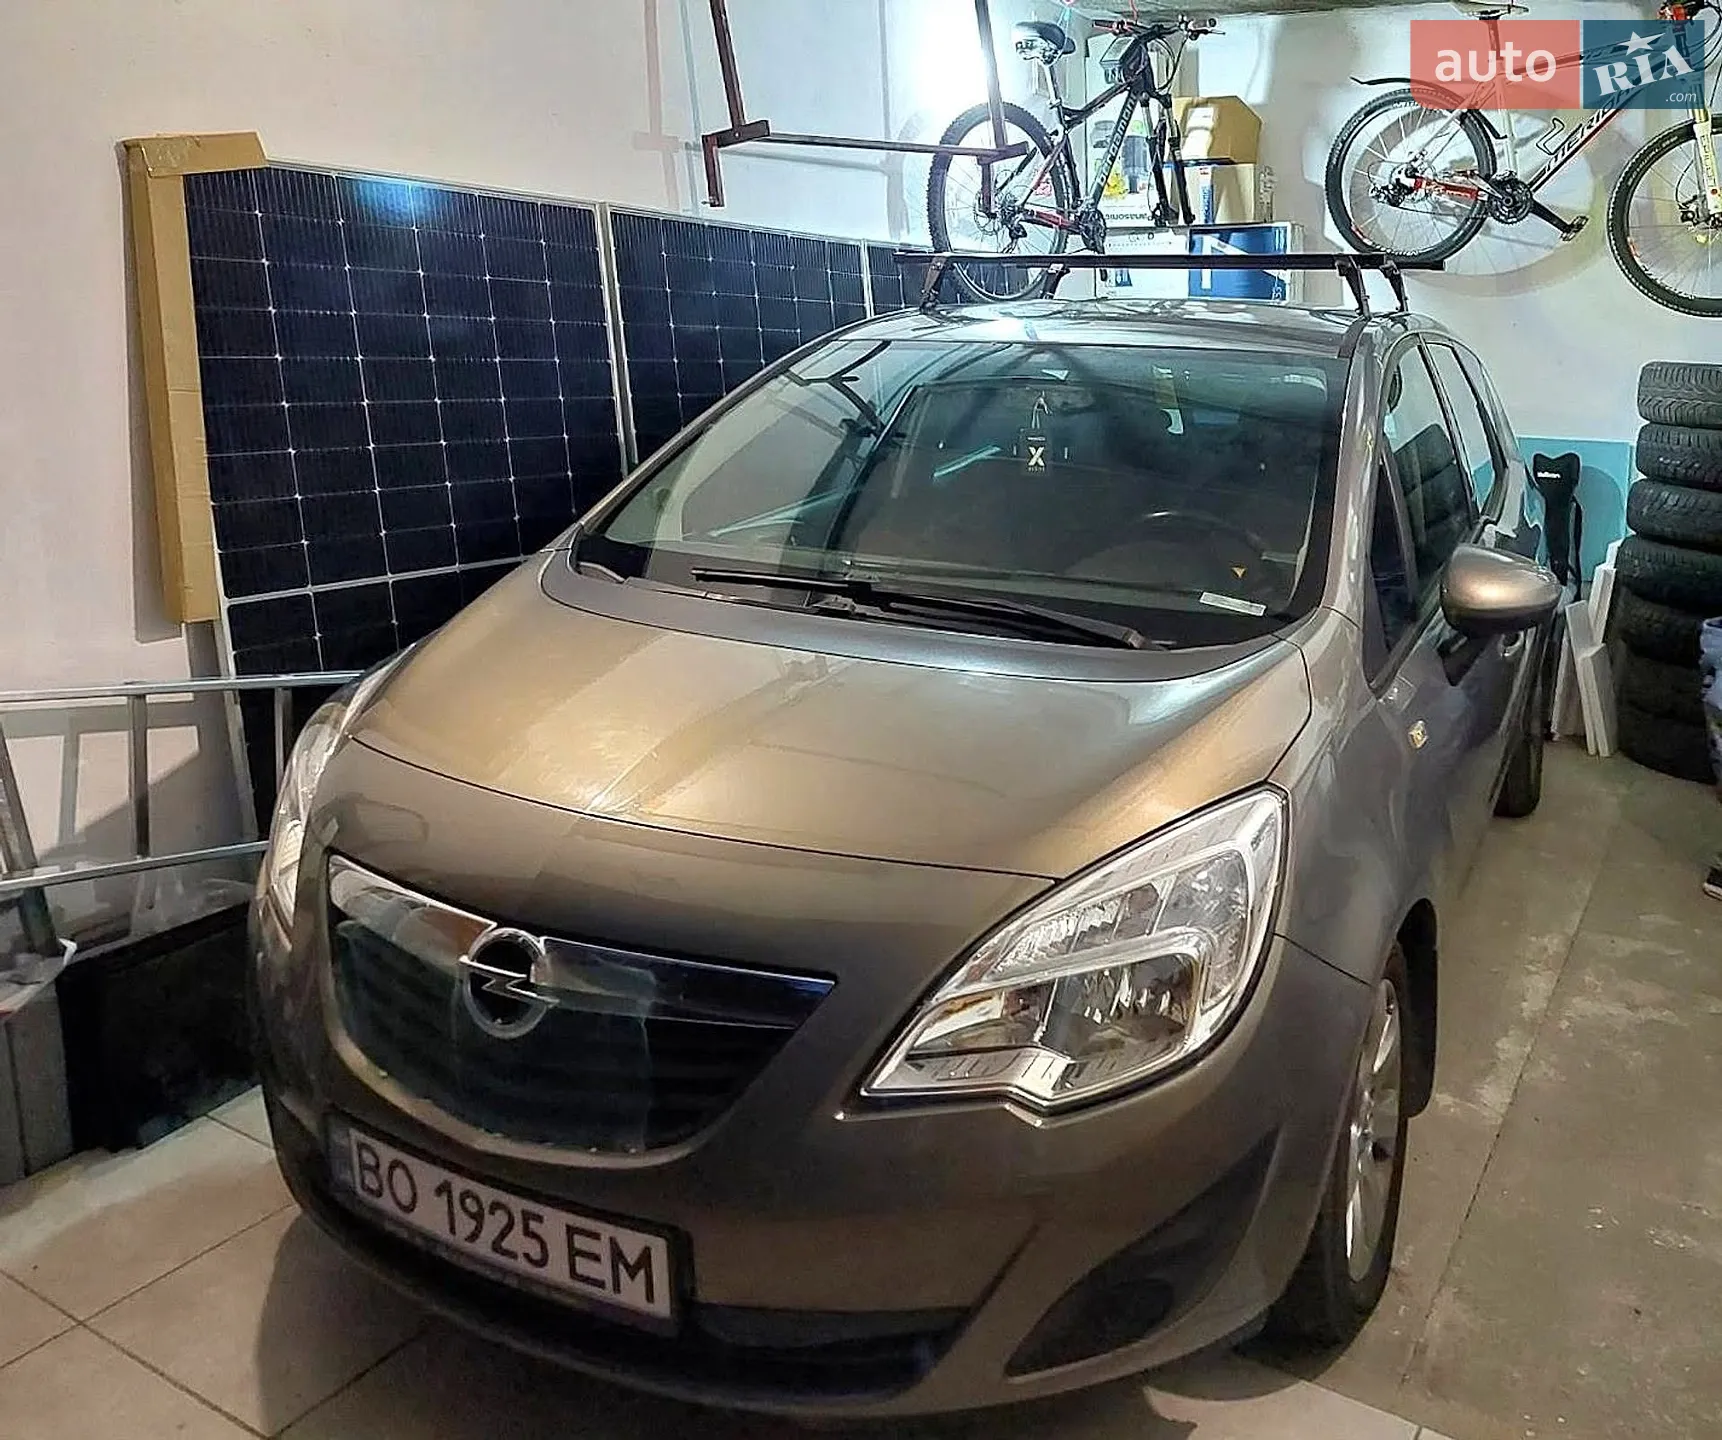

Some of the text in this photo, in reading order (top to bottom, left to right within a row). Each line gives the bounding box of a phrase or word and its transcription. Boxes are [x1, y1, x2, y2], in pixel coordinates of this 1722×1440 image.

[355, 1141, 655, 1304] BO 1925 EM
